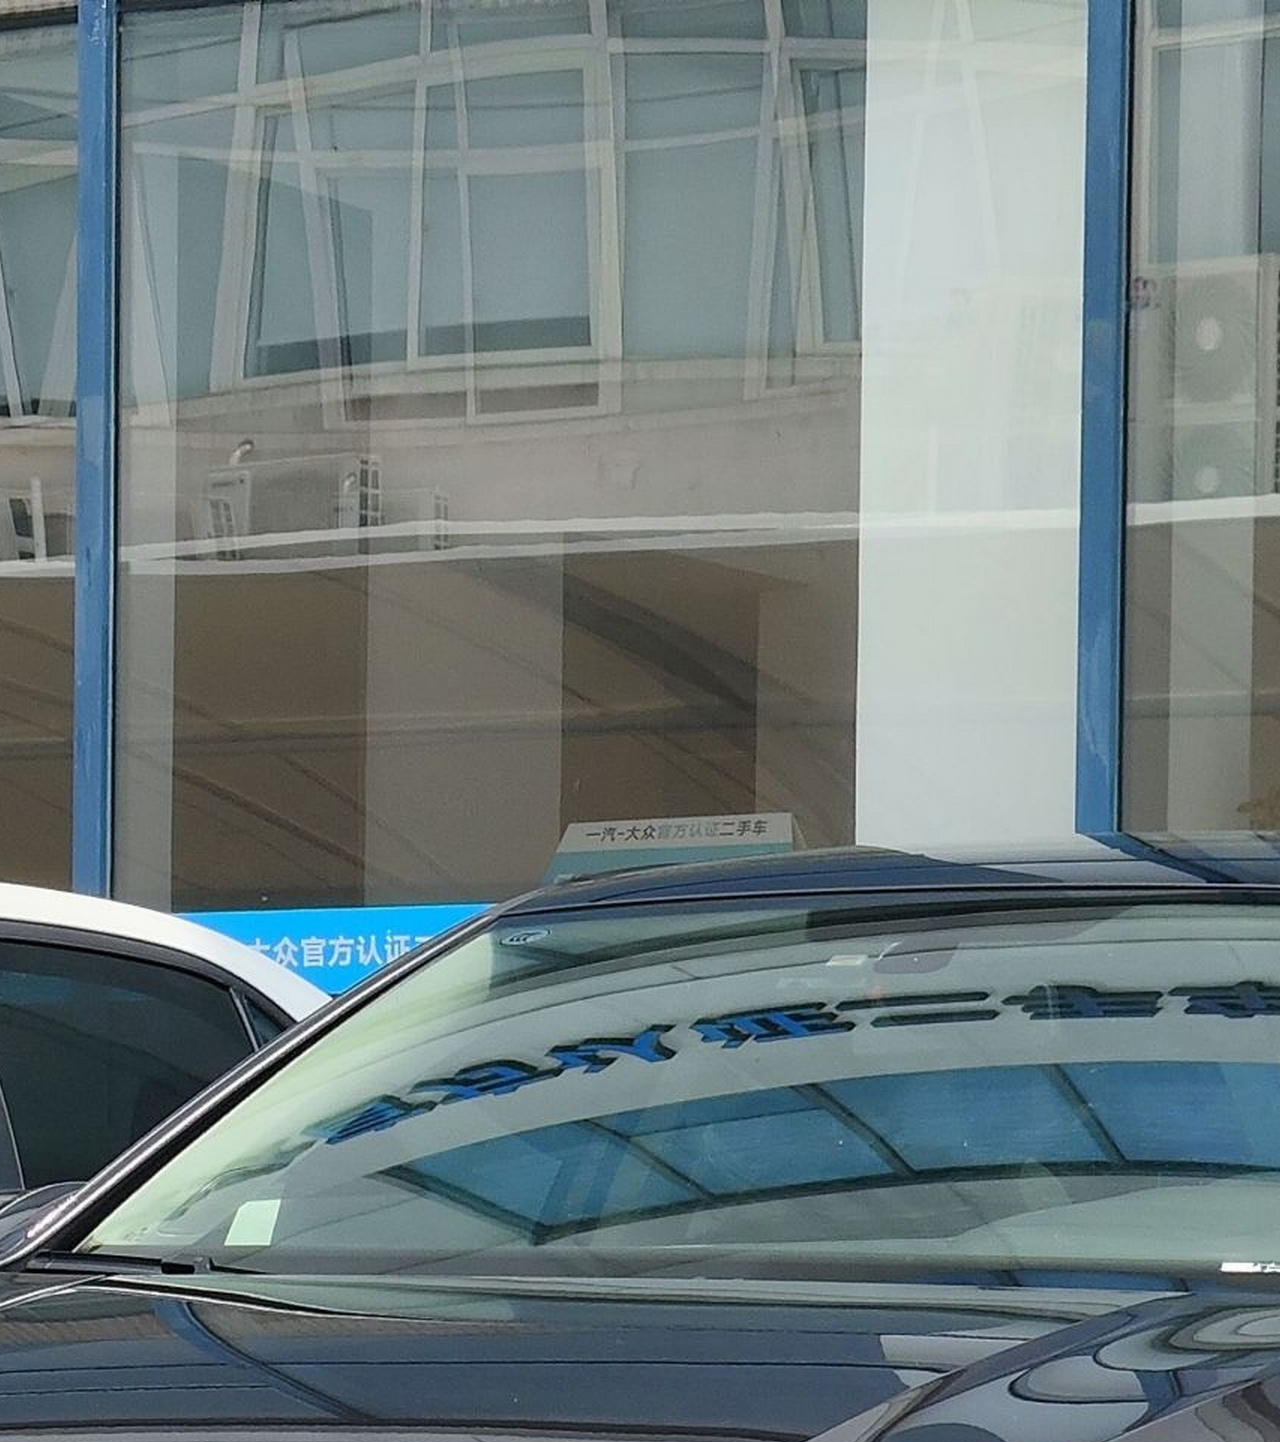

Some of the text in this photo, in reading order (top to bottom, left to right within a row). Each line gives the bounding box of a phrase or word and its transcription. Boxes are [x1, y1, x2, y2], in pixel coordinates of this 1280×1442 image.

[585, 819, 769, 843] 一汽-大众官方认证二手车
